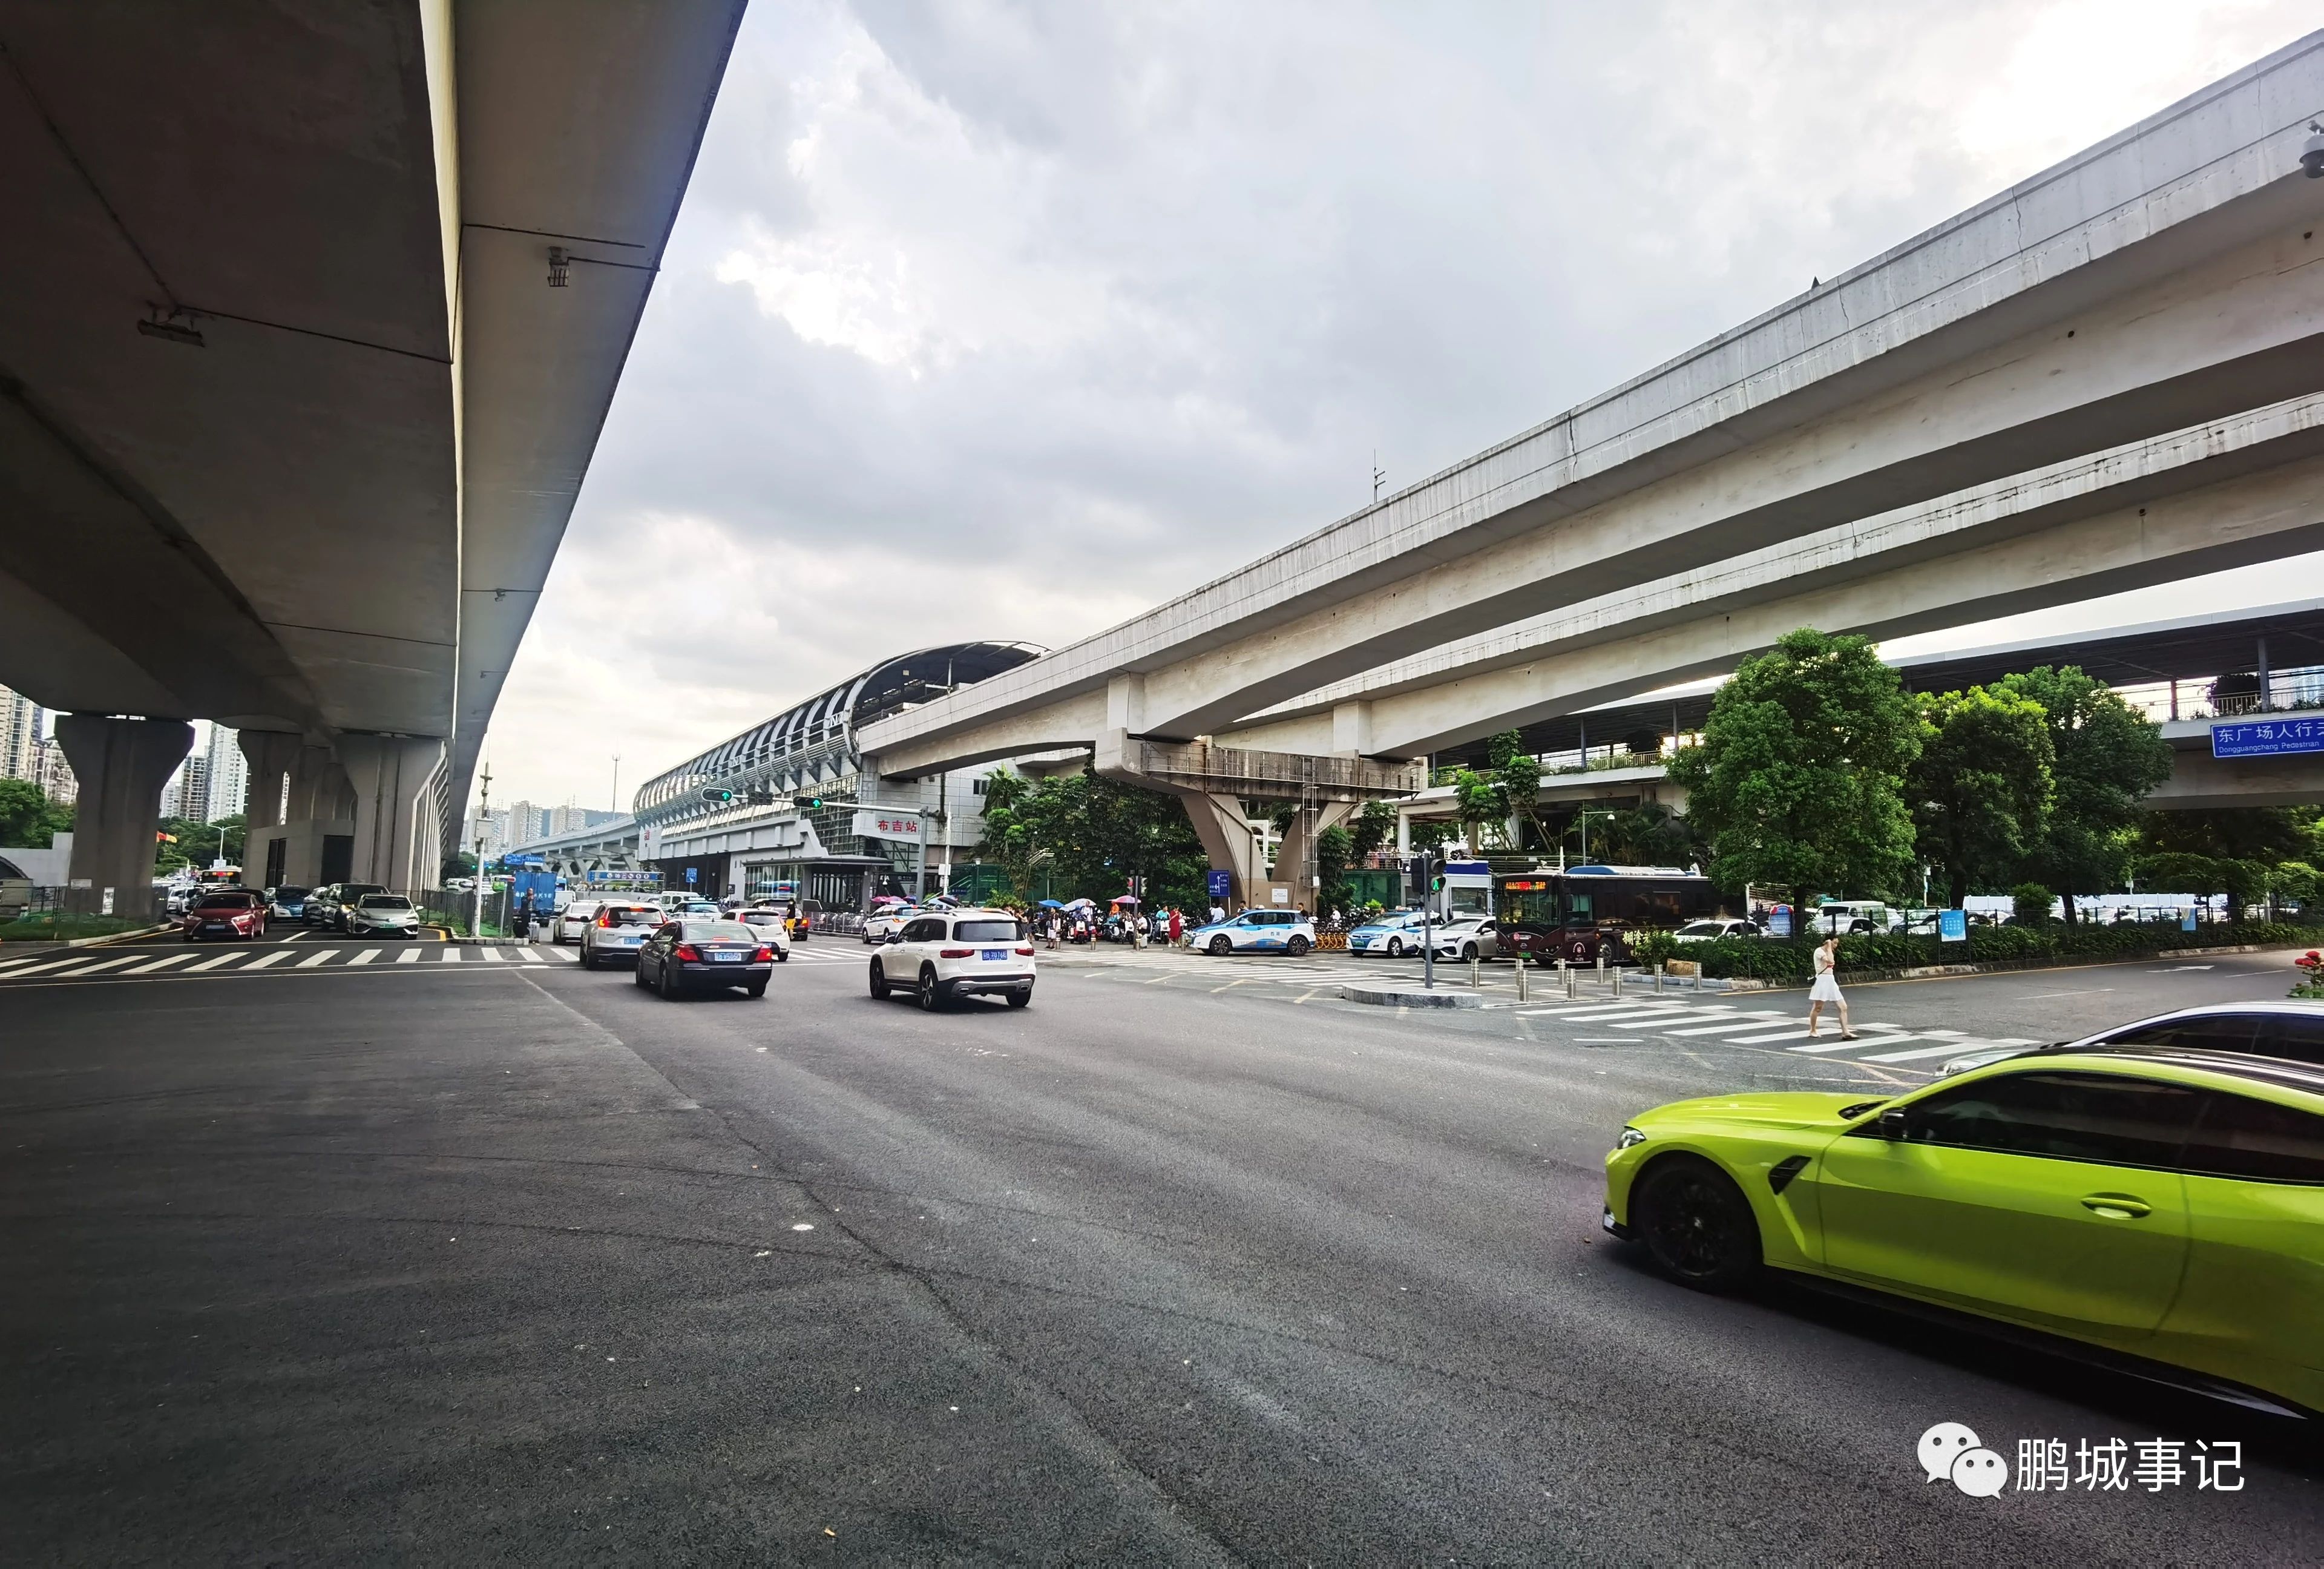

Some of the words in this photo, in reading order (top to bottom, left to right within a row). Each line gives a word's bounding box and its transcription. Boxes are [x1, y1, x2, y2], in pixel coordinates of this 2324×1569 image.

[2219, 744, 2279, 754] Dongguangchang
[878, 820, 917, 832] 布吉站
